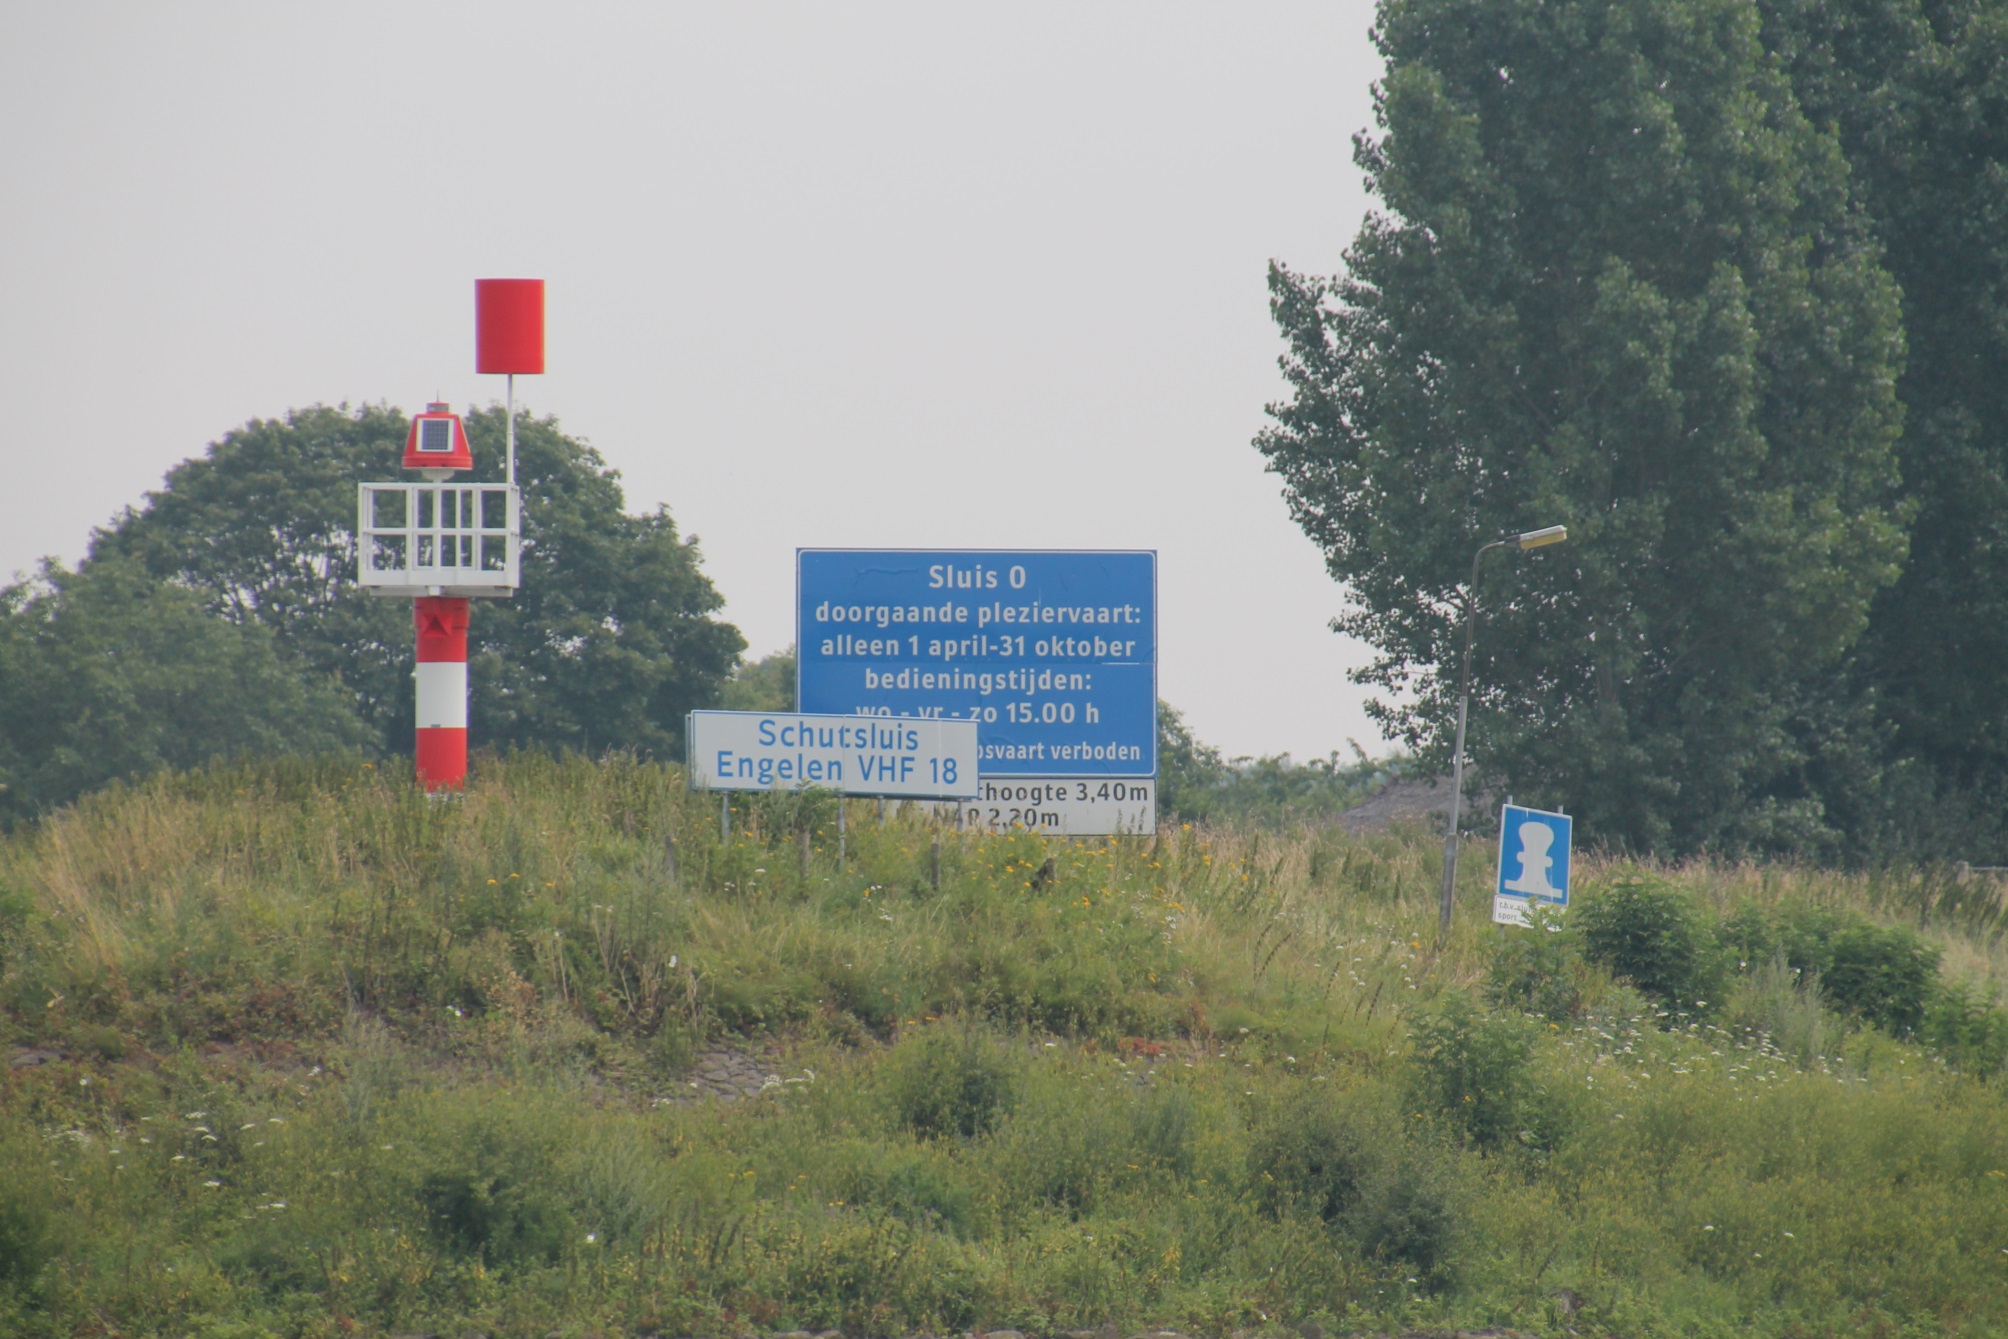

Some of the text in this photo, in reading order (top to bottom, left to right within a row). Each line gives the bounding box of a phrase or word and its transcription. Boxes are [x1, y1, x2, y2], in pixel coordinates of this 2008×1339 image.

[928, 564, 998, 590] Sluis
[815, 601, 1142, 628] doorgaande pleziervaart:
[820, 635, 1136, 661] alleen 1 april-31 oktober
[864, 667, 1093, 696] bedieningstijden:
[969, 706, 998, 724] zo
[1005, 702, 1076, 724] 15.00
[1085, 702, 1100, 724] h
[758, 718, 919, 751] Schutsluis
[1050, 741, 1141, 761] verboden
[717, 750, 959, 785] Engelen VHF 18
